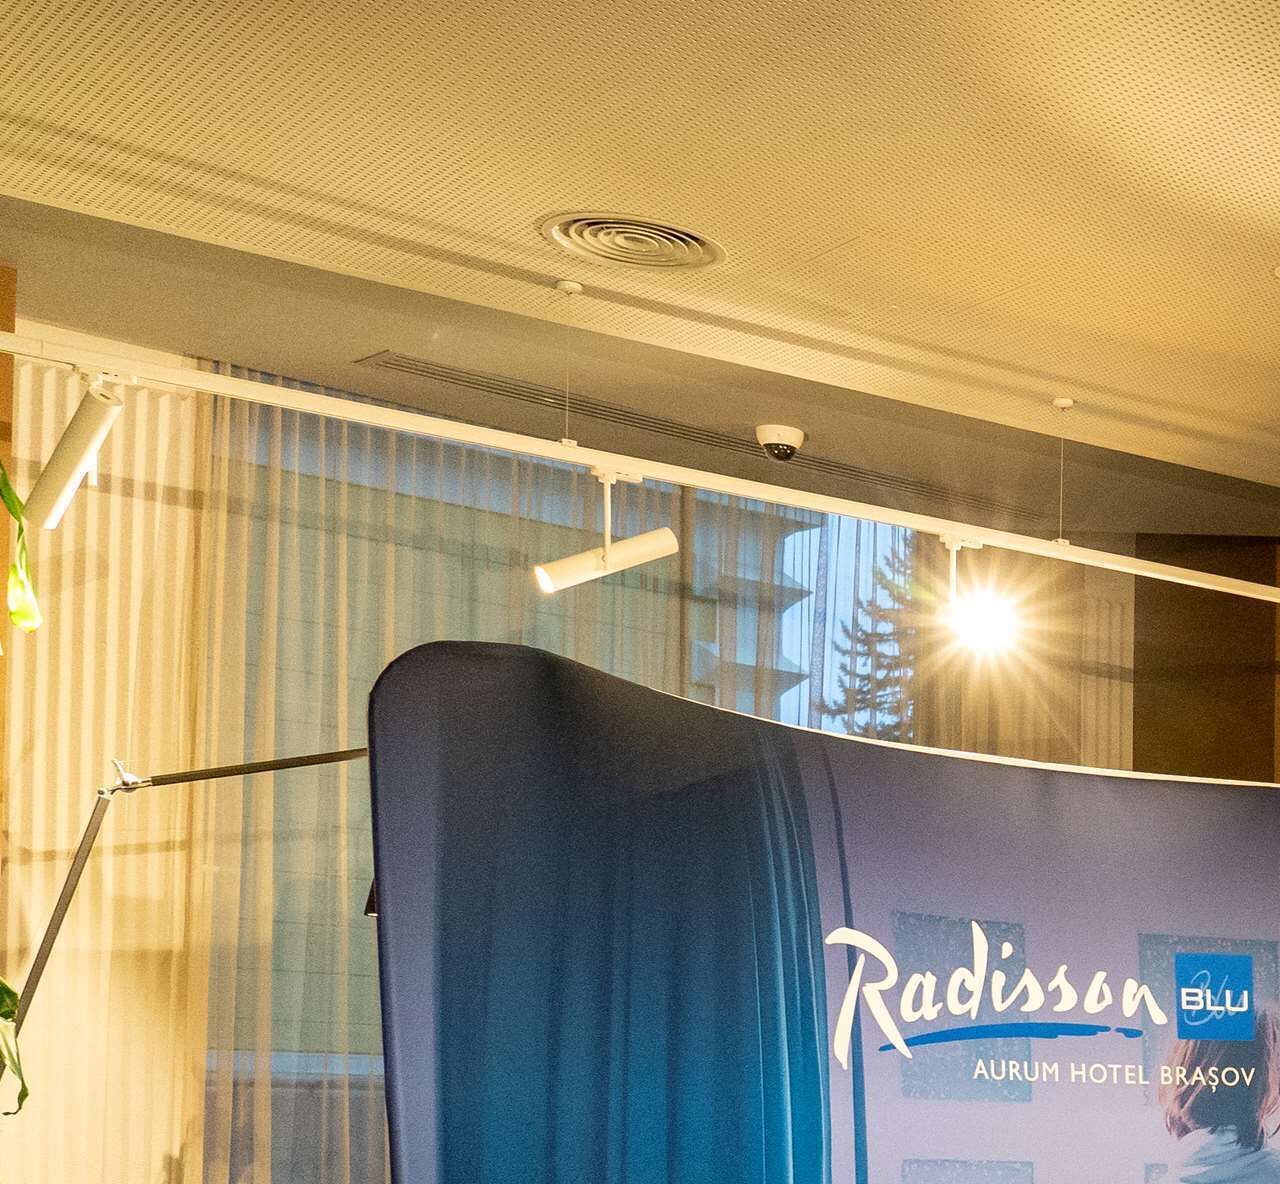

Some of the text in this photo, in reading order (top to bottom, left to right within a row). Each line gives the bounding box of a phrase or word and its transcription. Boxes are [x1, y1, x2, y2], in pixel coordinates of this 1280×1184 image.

[825, 920, 1249, 1070] Radisson BLU
[972, 1058, 1256, 1094] AURUM HOTEL BRAȘOV
